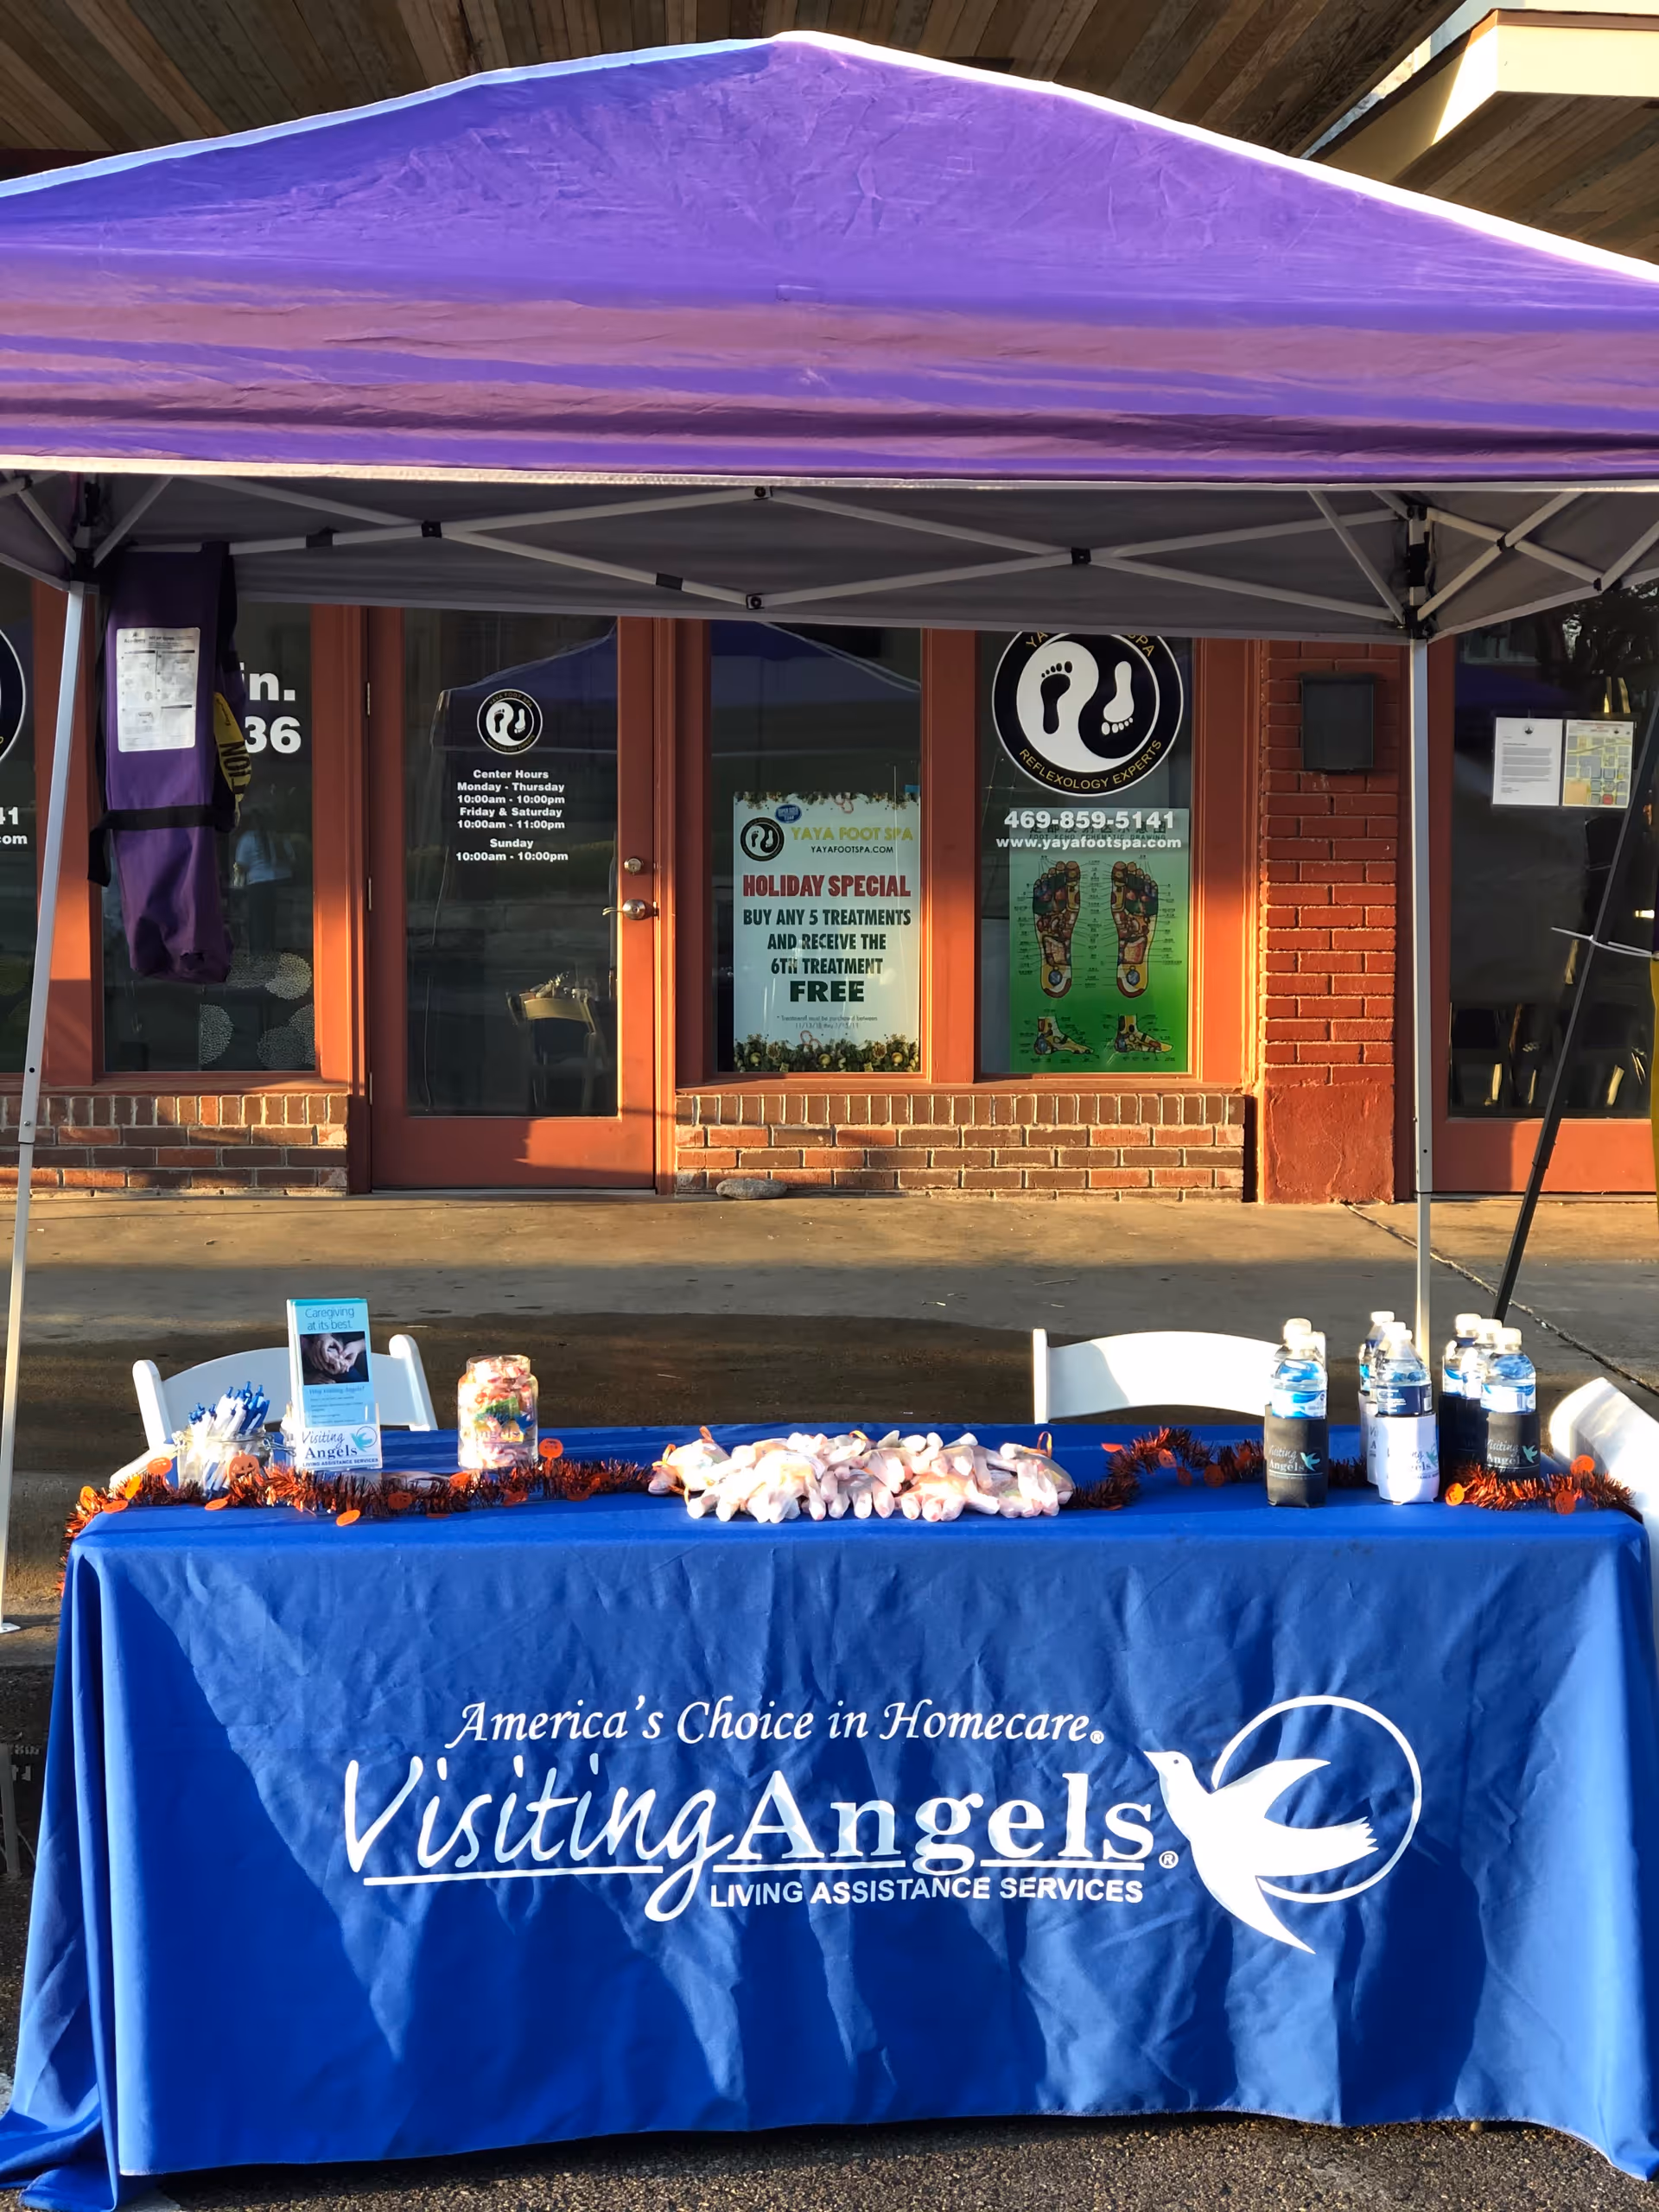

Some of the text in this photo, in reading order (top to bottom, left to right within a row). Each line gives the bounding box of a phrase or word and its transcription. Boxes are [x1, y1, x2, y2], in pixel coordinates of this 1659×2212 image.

[1020, 740, 1162, 790] REFLEXOLOGY EXPERTS
[473, 770, 549, 779] Center Hours
[457, 783, 501, 791] Monday
[512, 783, 564, 792] Thursday
[457, 795, 506, 804] 10:00am
[517, 795, 565, 805] 10:00pm
[460, 807, 563, 817] Friday & Saturday
[457, 820, 506, 829] 10:00am
[517, 820, 565, 830] 11:00pm
[1004, 810, 1174, 829] 469-859-5141
[791, 827, 913, 841] YAYA FOOT SPA
[490, 838, 534, 849] Sunday
[996, 836, 1182, 850] www.yayafootspa.com
[456, 852, 506, 861] 10:00am
[518, 852, 569, 862] 10:00pm
[743, 874, 912, 897] HOLIDAY SPECIAL
[743, 909, 912, 925] BUY ANY 5 TREATMENTS
[767, 933, 887, 950] AND RECEIVE THE
[771, 958, 883, 974] 6TH TREATMENT
[790, 981, 865, 1002] FREE
[305, 1307, 354, 1320] Caregiving
[307, 1322, 315, 1331] at
[318, 1321, 329, 1330] its
[302, 1430, 345, 1447] Visiting
[305, 1446, 358, 1460] Angels
[445, 1694, 664, 1749] America’s
[677, 1695, 813, 1744] Choice
[829, 1700, 868, 1738] in
[346, 1752, 734, 1922] Visiting
[710, 1878, 1143, 1908] LIVING ASSISTANCE SERVICES
